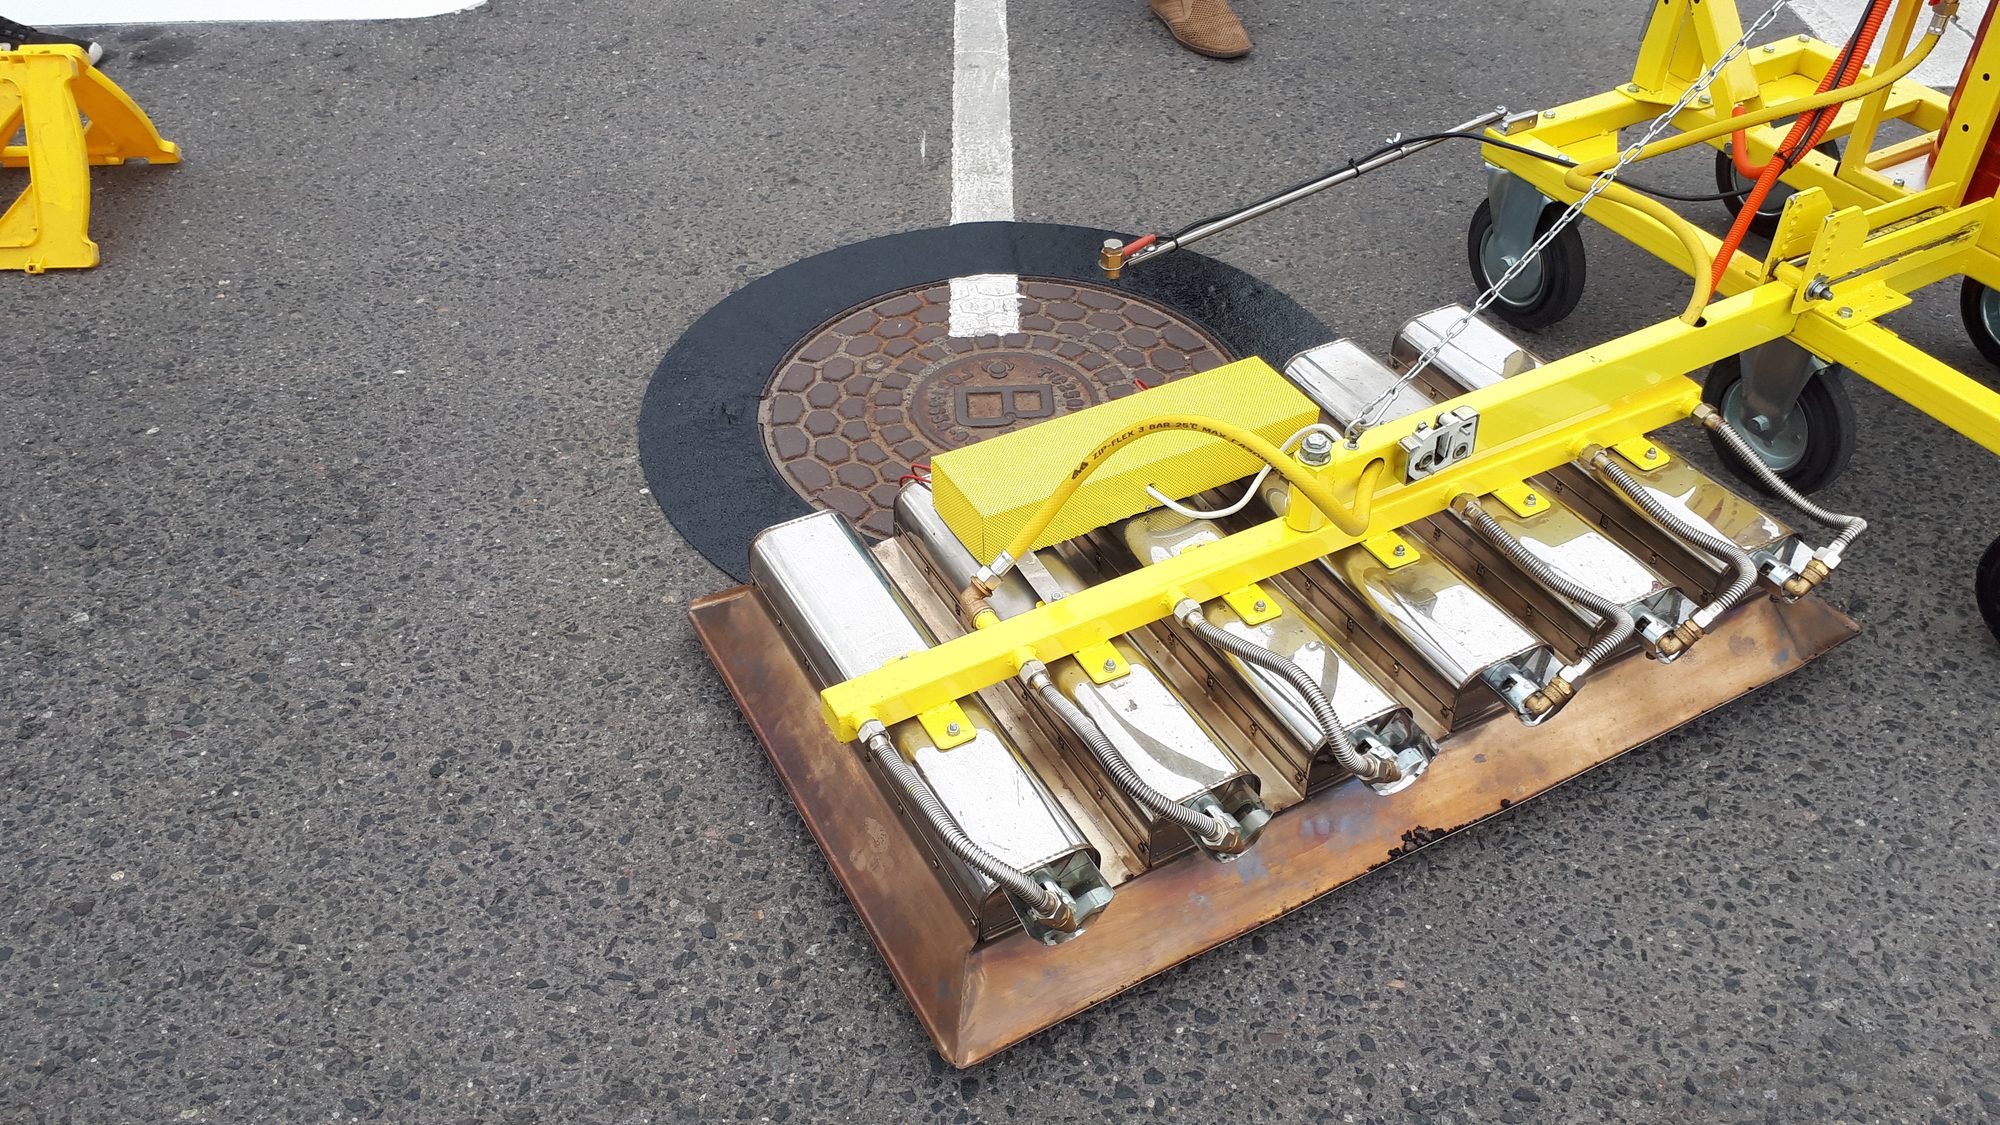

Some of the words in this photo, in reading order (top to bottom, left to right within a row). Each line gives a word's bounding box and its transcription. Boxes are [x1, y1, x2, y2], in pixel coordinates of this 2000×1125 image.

[1092, 430, 1135, 460] ZIP-FLEX
[1149, 422, 1171, 430] BAR
[1202, 427, 1227, 439] MAX
